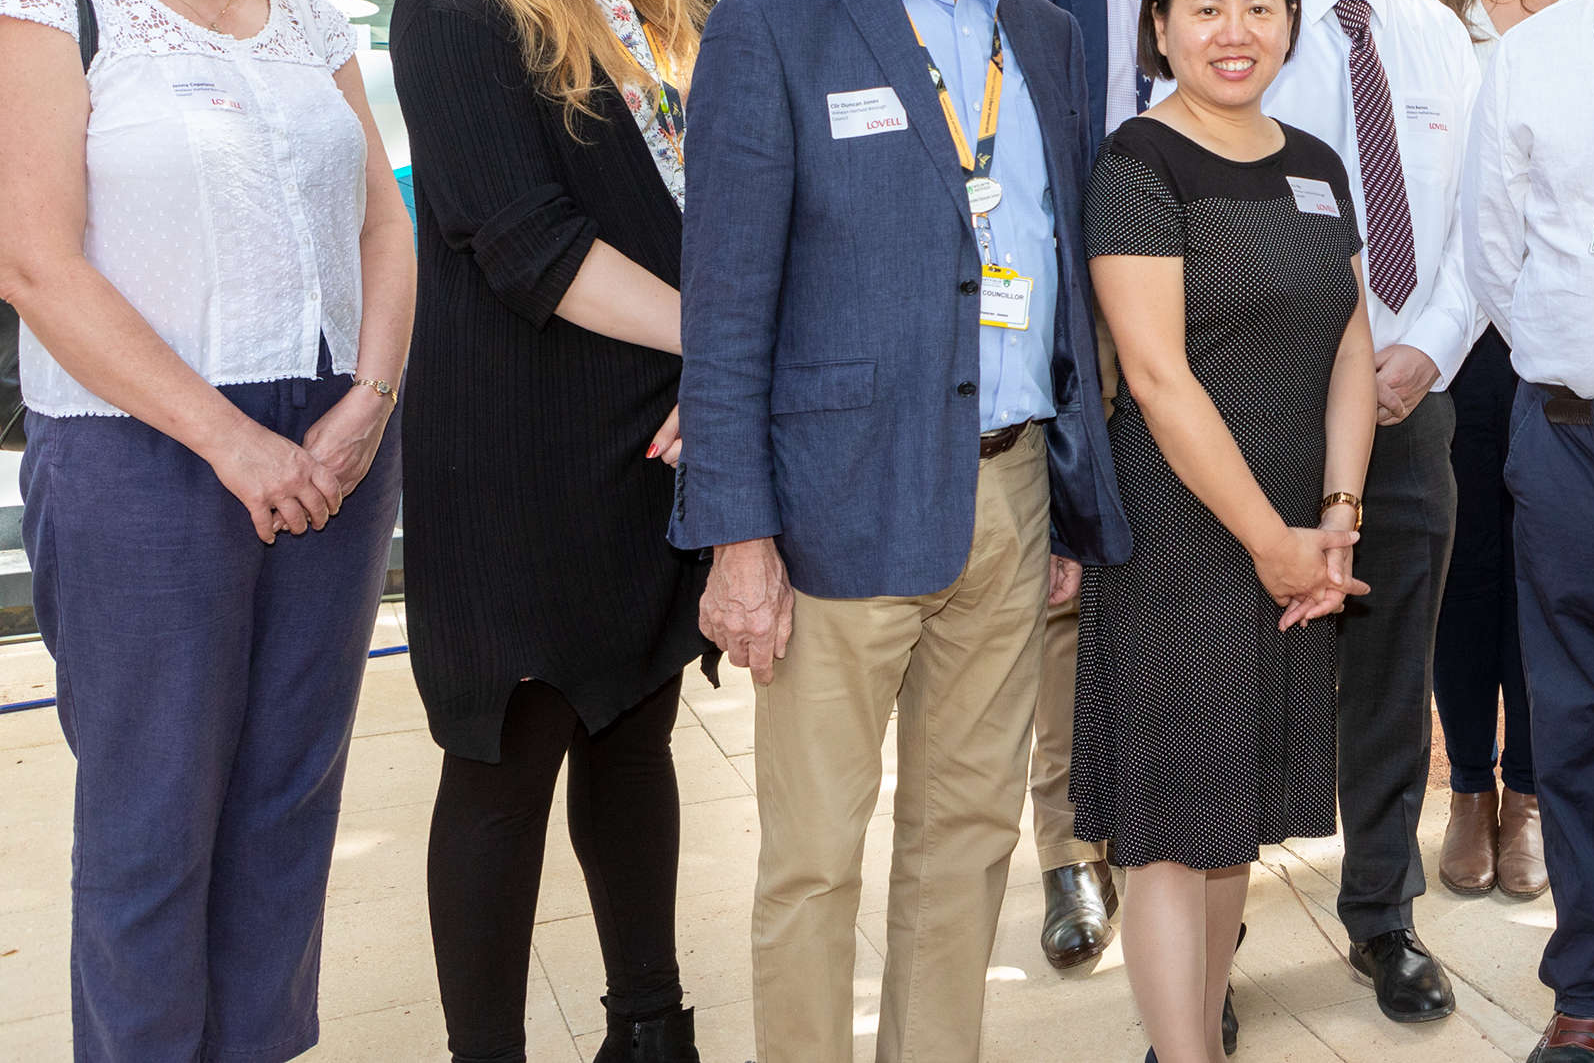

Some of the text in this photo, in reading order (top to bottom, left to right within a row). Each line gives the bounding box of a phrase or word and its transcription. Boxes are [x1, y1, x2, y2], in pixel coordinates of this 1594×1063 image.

[211, 98, 243, 110] LOVELL
[831, 98, 879, 110] Cllr Duncan Jones
[866, 117, 902, 130] LOVELL
[1429, 122, 1448, 132] LOVELL
[1316, 203, 1337, 213] LOVELL
[982, 289, 1024, 301] COUNCILLOR
